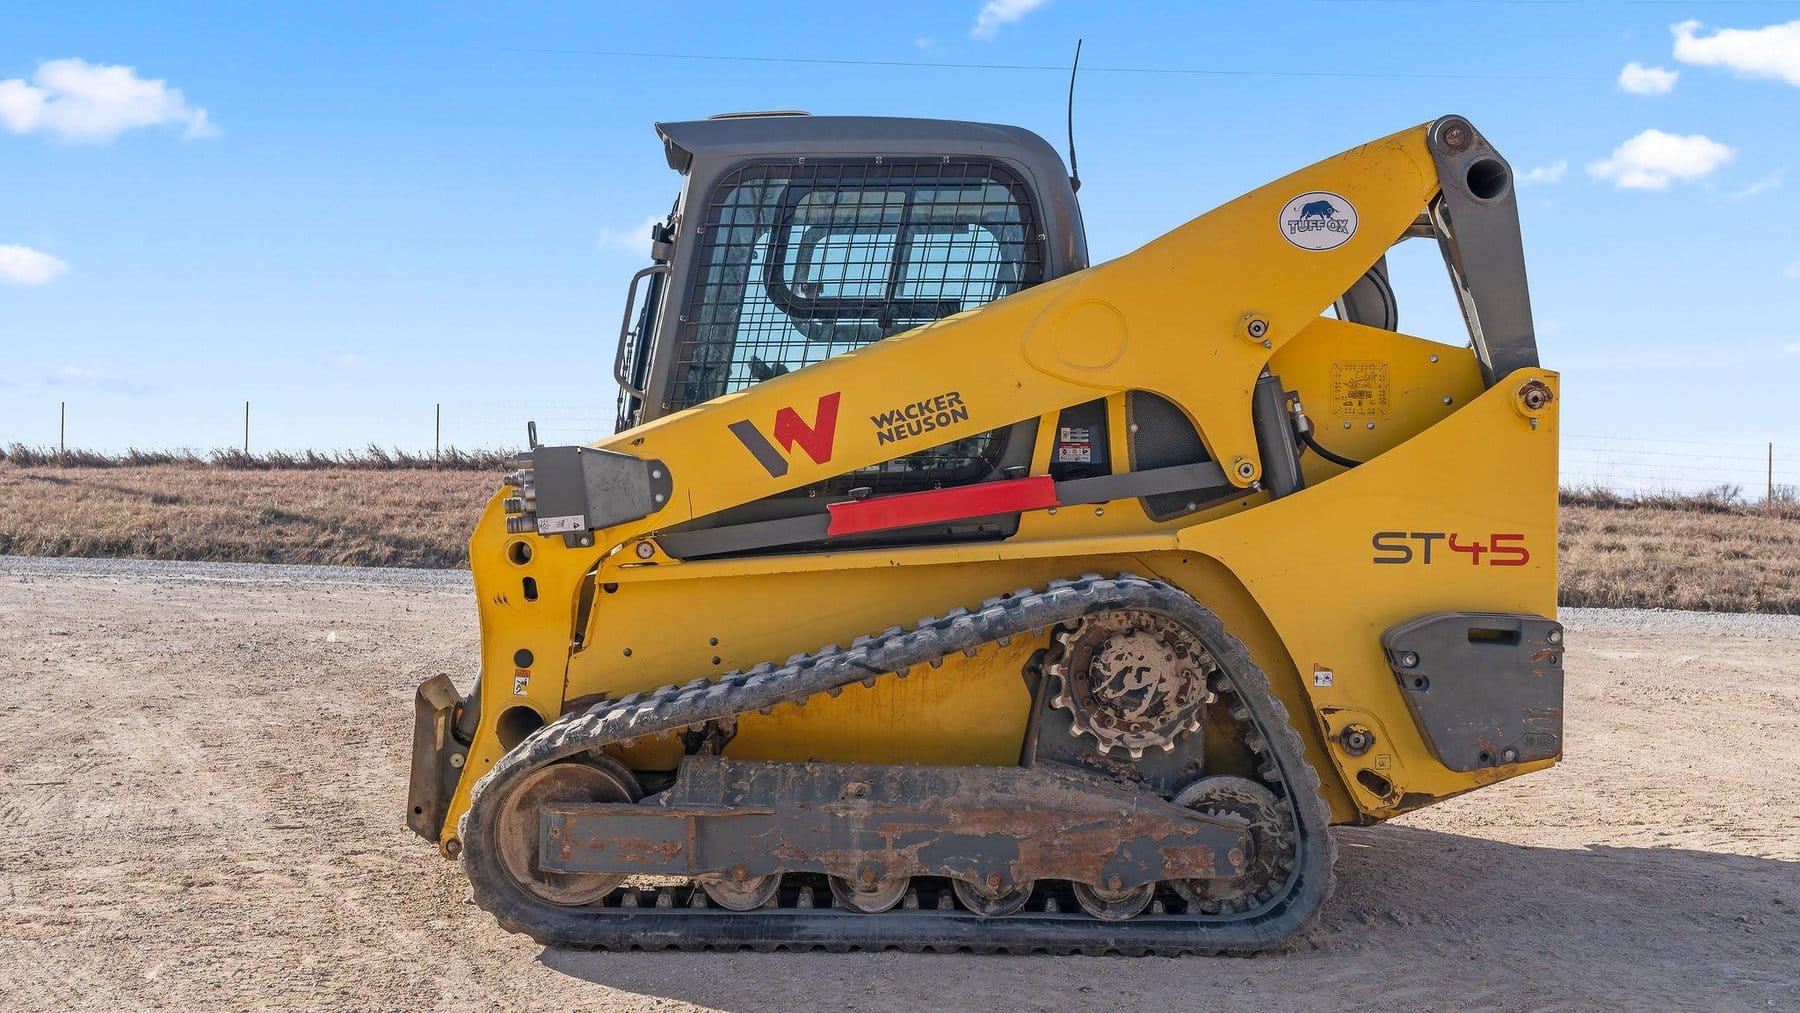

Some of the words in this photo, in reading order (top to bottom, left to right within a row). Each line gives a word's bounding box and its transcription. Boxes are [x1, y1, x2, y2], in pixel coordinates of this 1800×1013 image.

[1288, 219, 1325, 234] TUFF
[1327, 219, 1349, 234] OX
[871, 391, 964, 429] WACKER
[877, 405, 969, 446] NEUSON
[1372, 532, 1530, 566] ST45
